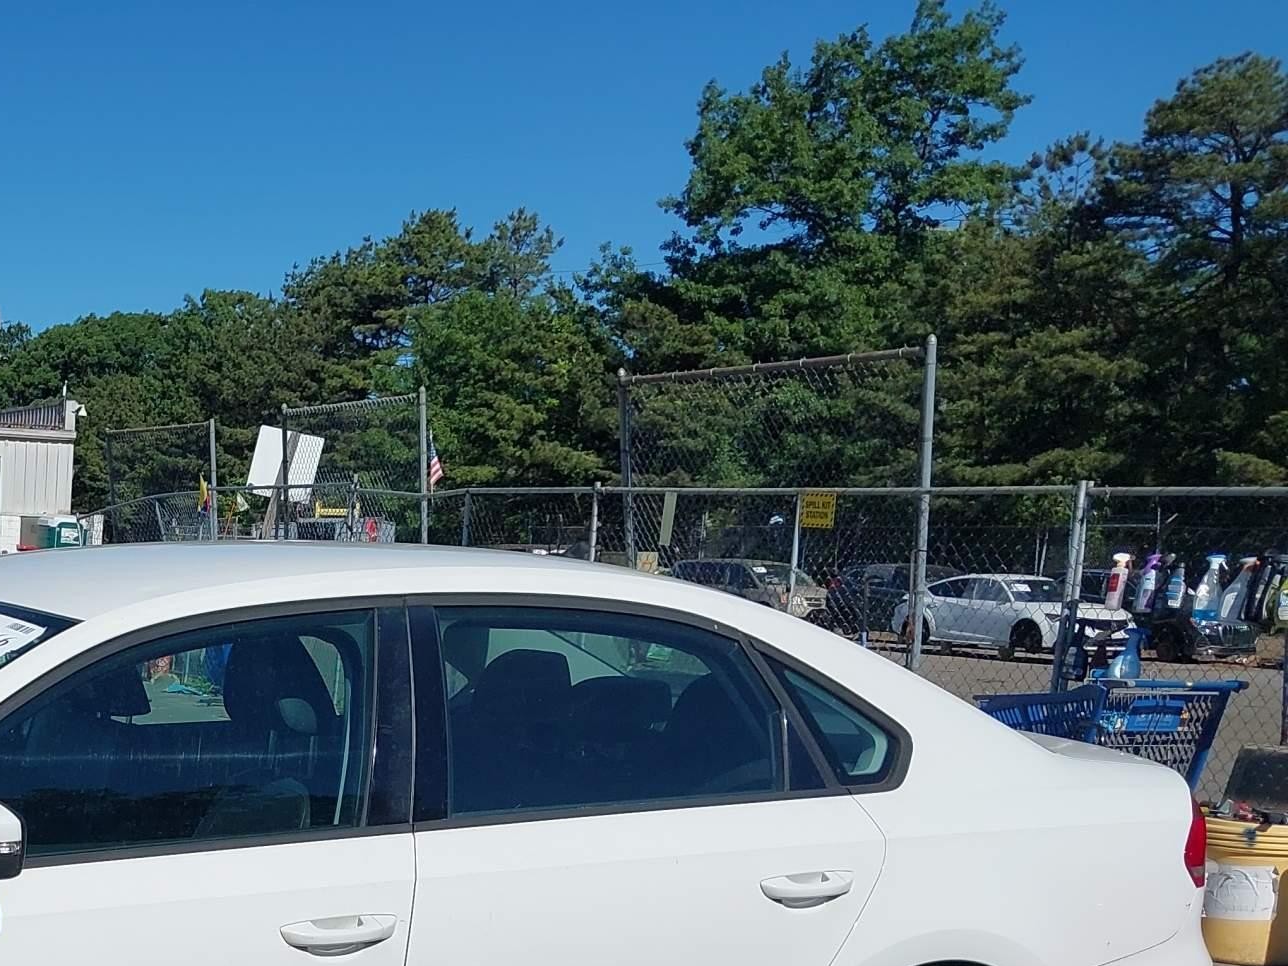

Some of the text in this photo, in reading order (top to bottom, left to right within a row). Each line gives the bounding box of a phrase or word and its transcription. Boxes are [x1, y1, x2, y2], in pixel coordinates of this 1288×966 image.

[805, 500, 831, 509] SPILL KIT
[805, 510, 829, 519] STATION
